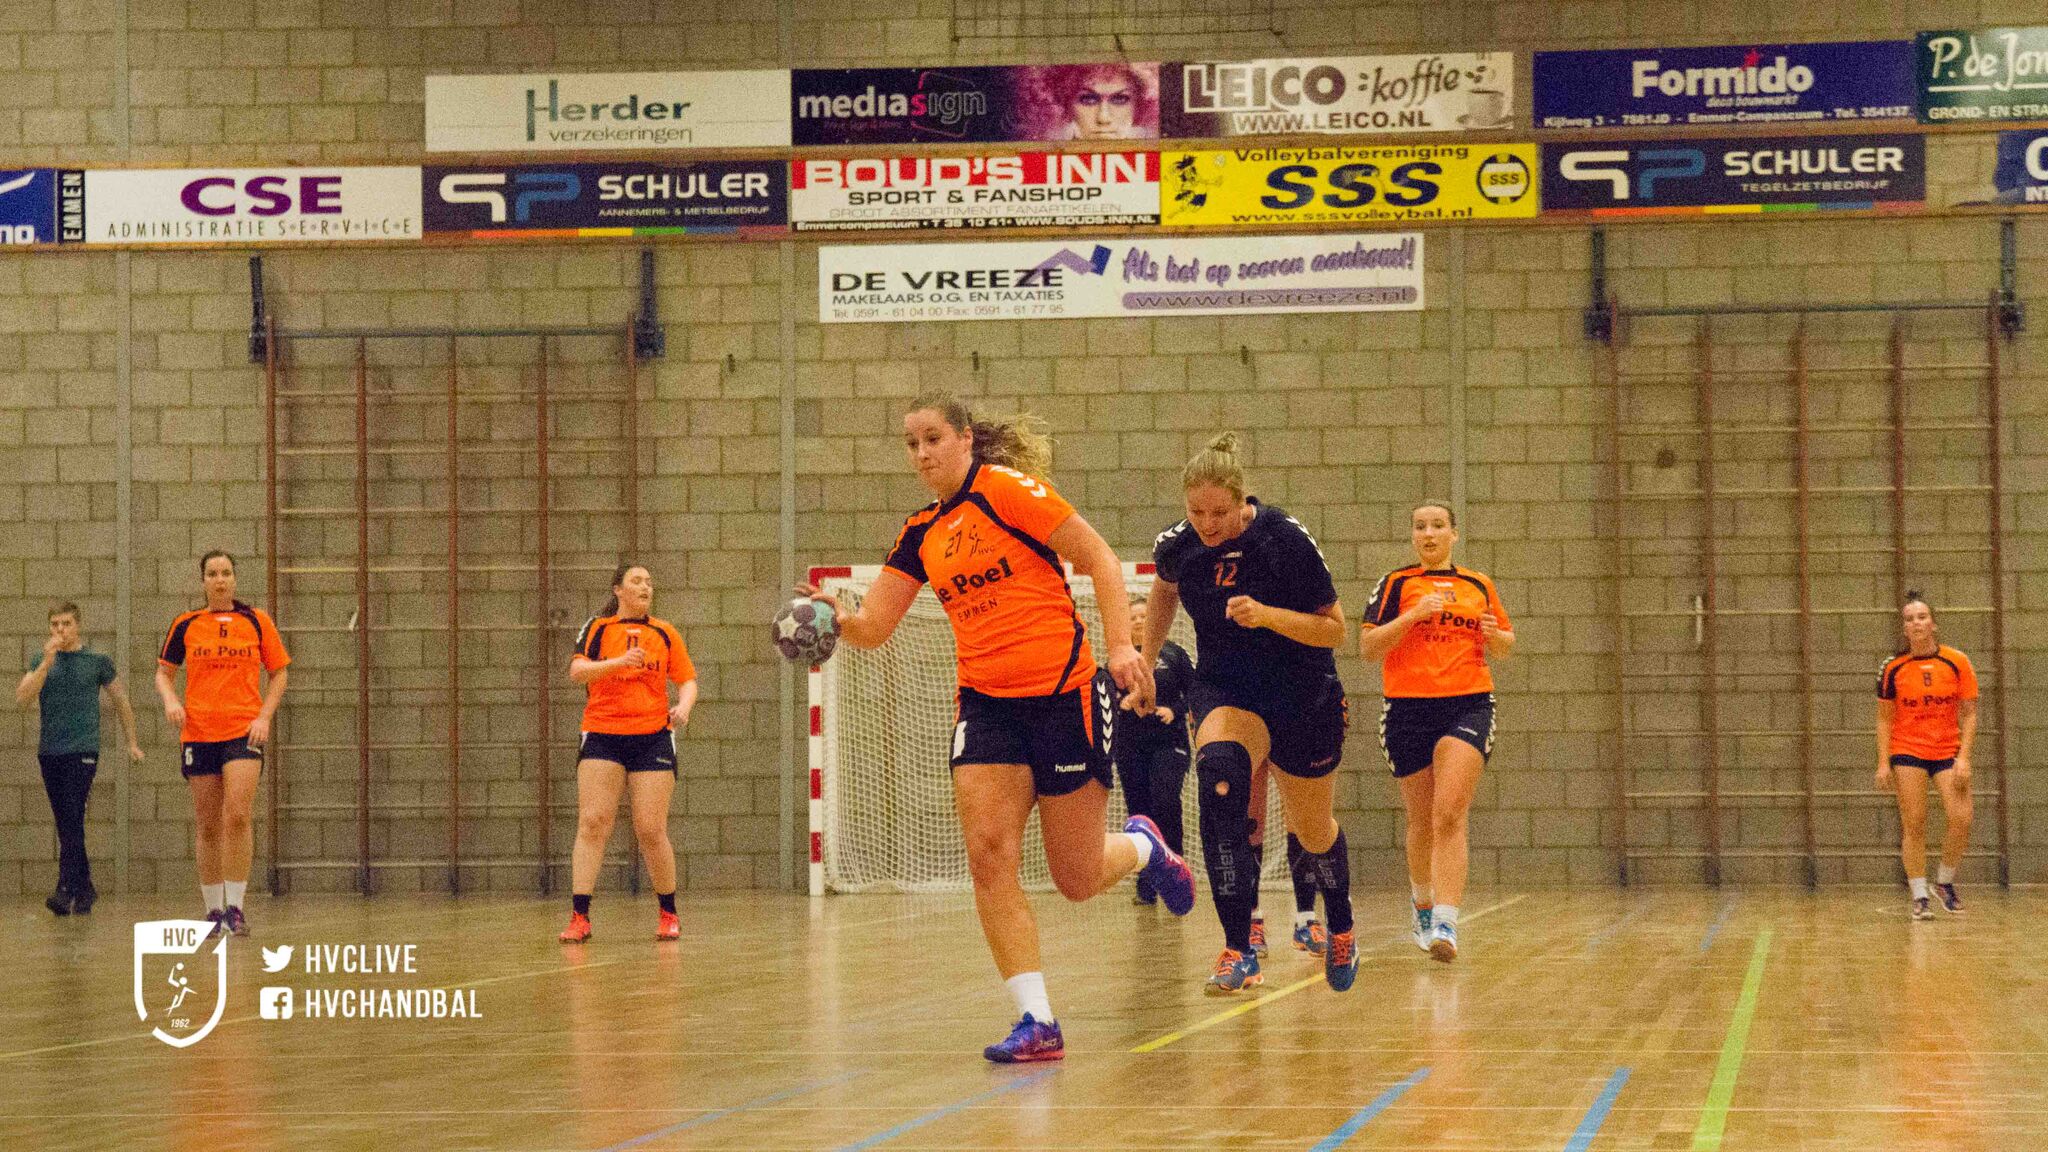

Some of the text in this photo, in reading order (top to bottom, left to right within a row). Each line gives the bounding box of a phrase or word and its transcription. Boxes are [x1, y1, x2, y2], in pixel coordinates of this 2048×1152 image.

[1963, 35, 1999, 78] de
[1185, 63, 1347, 112] LEICO
[1371, 57, 1460, 107] koffie
[1632, 56, 1814, 98] Formido
[526, 79, 691, 142] Herder
[1235, 111, 1431, 133] WWW.LEICO.NL
[1989, 105, 2010, 118] EN
[549, 125, 693, 144] verzekeringen
[1235, 147, 1470, 163] Volleybalvereniging
[1722, 147, 1904, 177] SCHULER
[805, 152, 1148, 189] BOUD'S INN
[1490, 173, 1520, 186] SSS
[180, 175, 343, 216] CSE
[598, 172, 769, 202] SCHULER
[848, 187, 1103, 206] SPORT & FANSHOP
[1260, 161, 1443, 210] SSS
[1741, 180, 1890, 193] TEGELZETBEDRIJF
[63, 173, 82, 240] EMMEN
[829, 203, 1122, 219] GROOT ASSORTIMENT FANARTIKELEN
[1232, 207, 1473, 223] www.sssvolleybal.nl
[108, 219, 265, 237] ADMINISTRATIE
[932, 219, 941, 228] T
[967, 218, 985, 227] 10
[988, 217, 1006, 227] 41
[1123, 246, 1159, 283] Als
[1206, 262, 1232, 288] op
[832, 268, 1063, 292] DE VREEZE
[832, 291, 924, 305] MAKELAARS
[969, 290, 990, 302] EN
[993, 289, 1064, 301] TAXATIES
[1136, 286, 1409, 308] www.devreeze.nl
[853, 308, 880, 318] 0591
[950, 555, 1014, 596] Poel
[1213, 561, 1238, 588] 12
